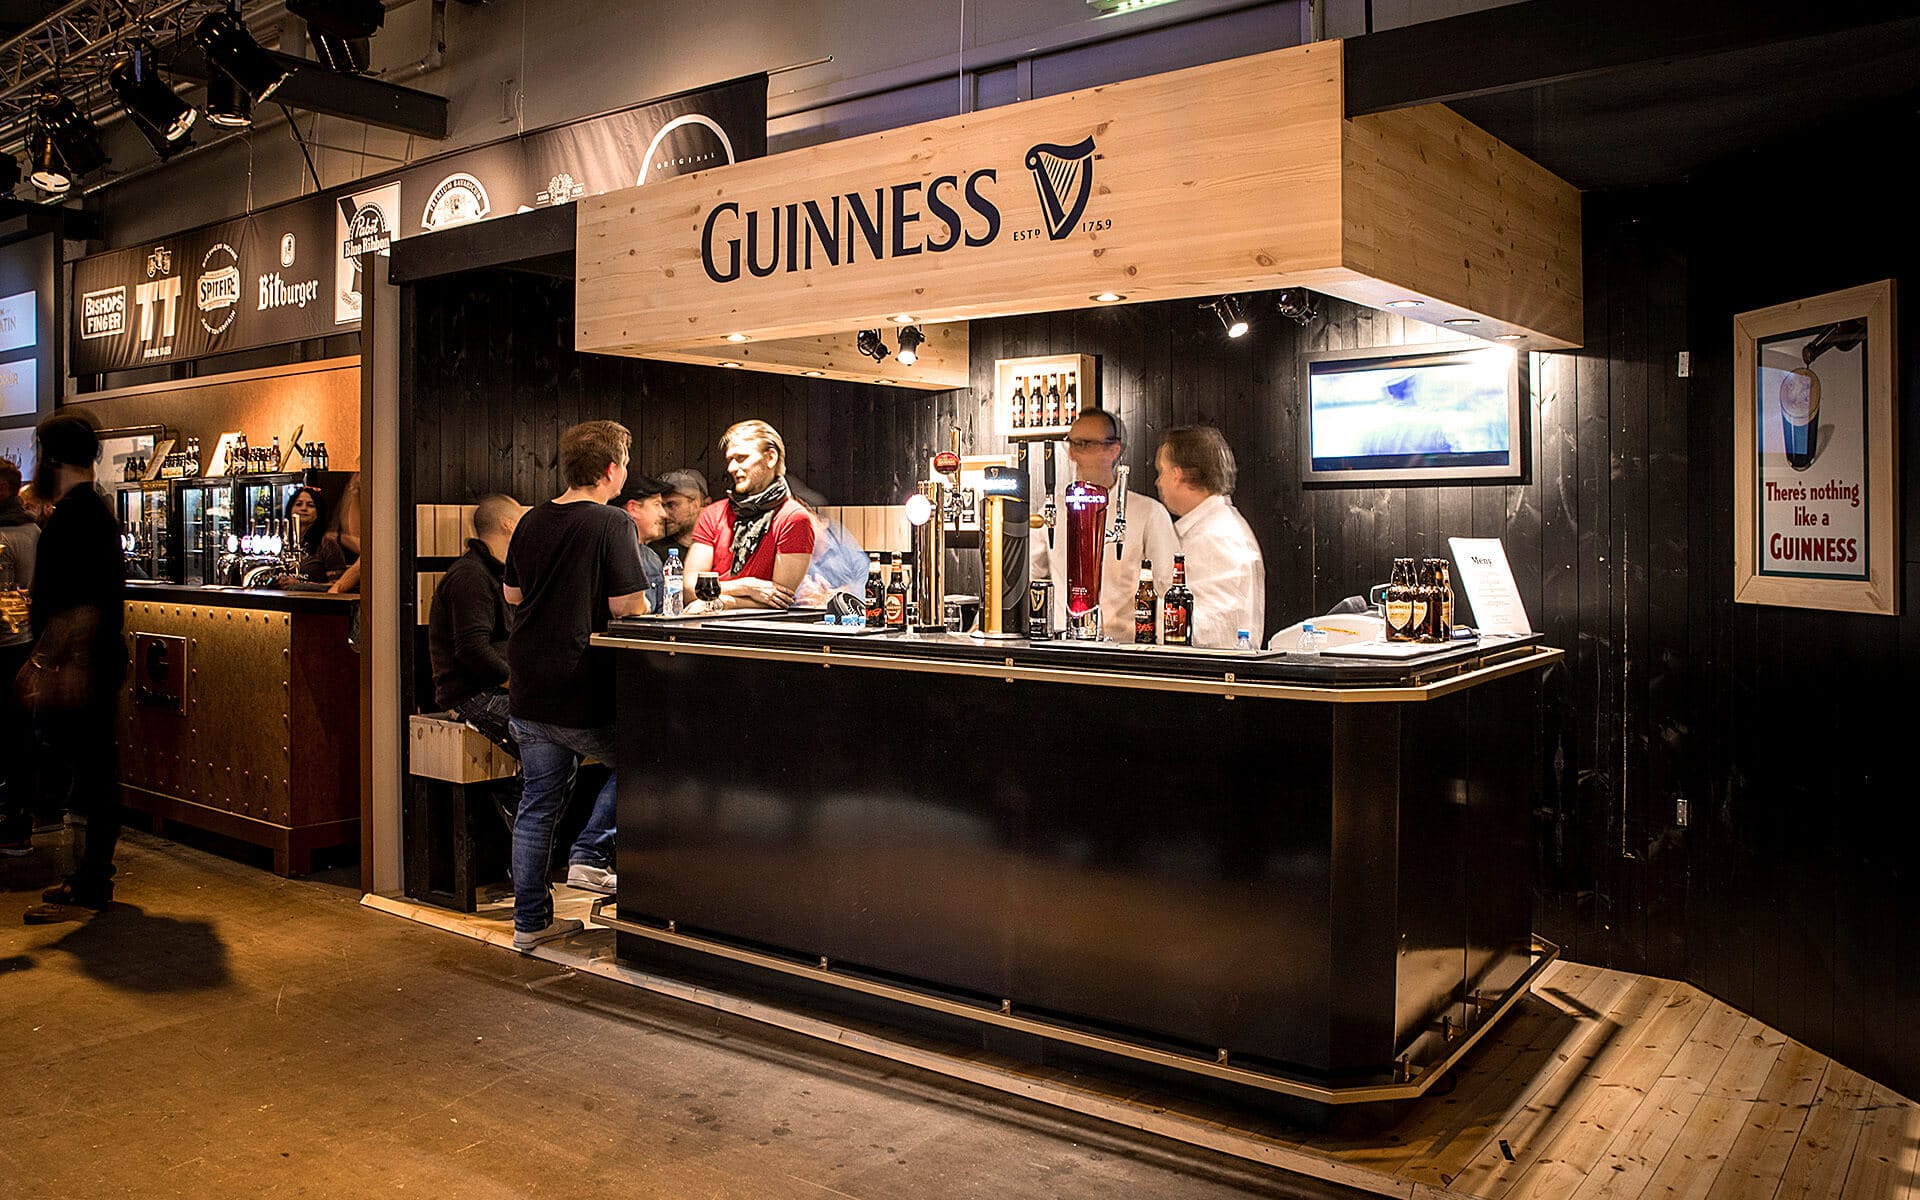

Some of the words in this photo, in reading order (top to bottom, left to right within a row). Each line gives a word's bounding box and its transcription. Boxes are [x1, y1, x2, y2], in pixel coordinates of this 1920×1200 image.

[656, 152, 716, 170] ORIGINAL
[355, 215, 379, 238] Pabst
[701, 168, 1002, 284] GUINNESS
[1082, 218, 1112, 233] 1759
[344, 240, 362, 257] Blue
[362, 235, 390, 253] Ribbon
[257, 271, 319, 311] Bitburger
[87, 312, 121, 334] FINGER
[1765, 480, 1807, 501] There's
[1810, 479, 1860, 508] nothing
[1794, 505, 1818, 526] like
[1821, 512, 1830, 526] a
[1770, 532, 1858, 563] GUINNESS
